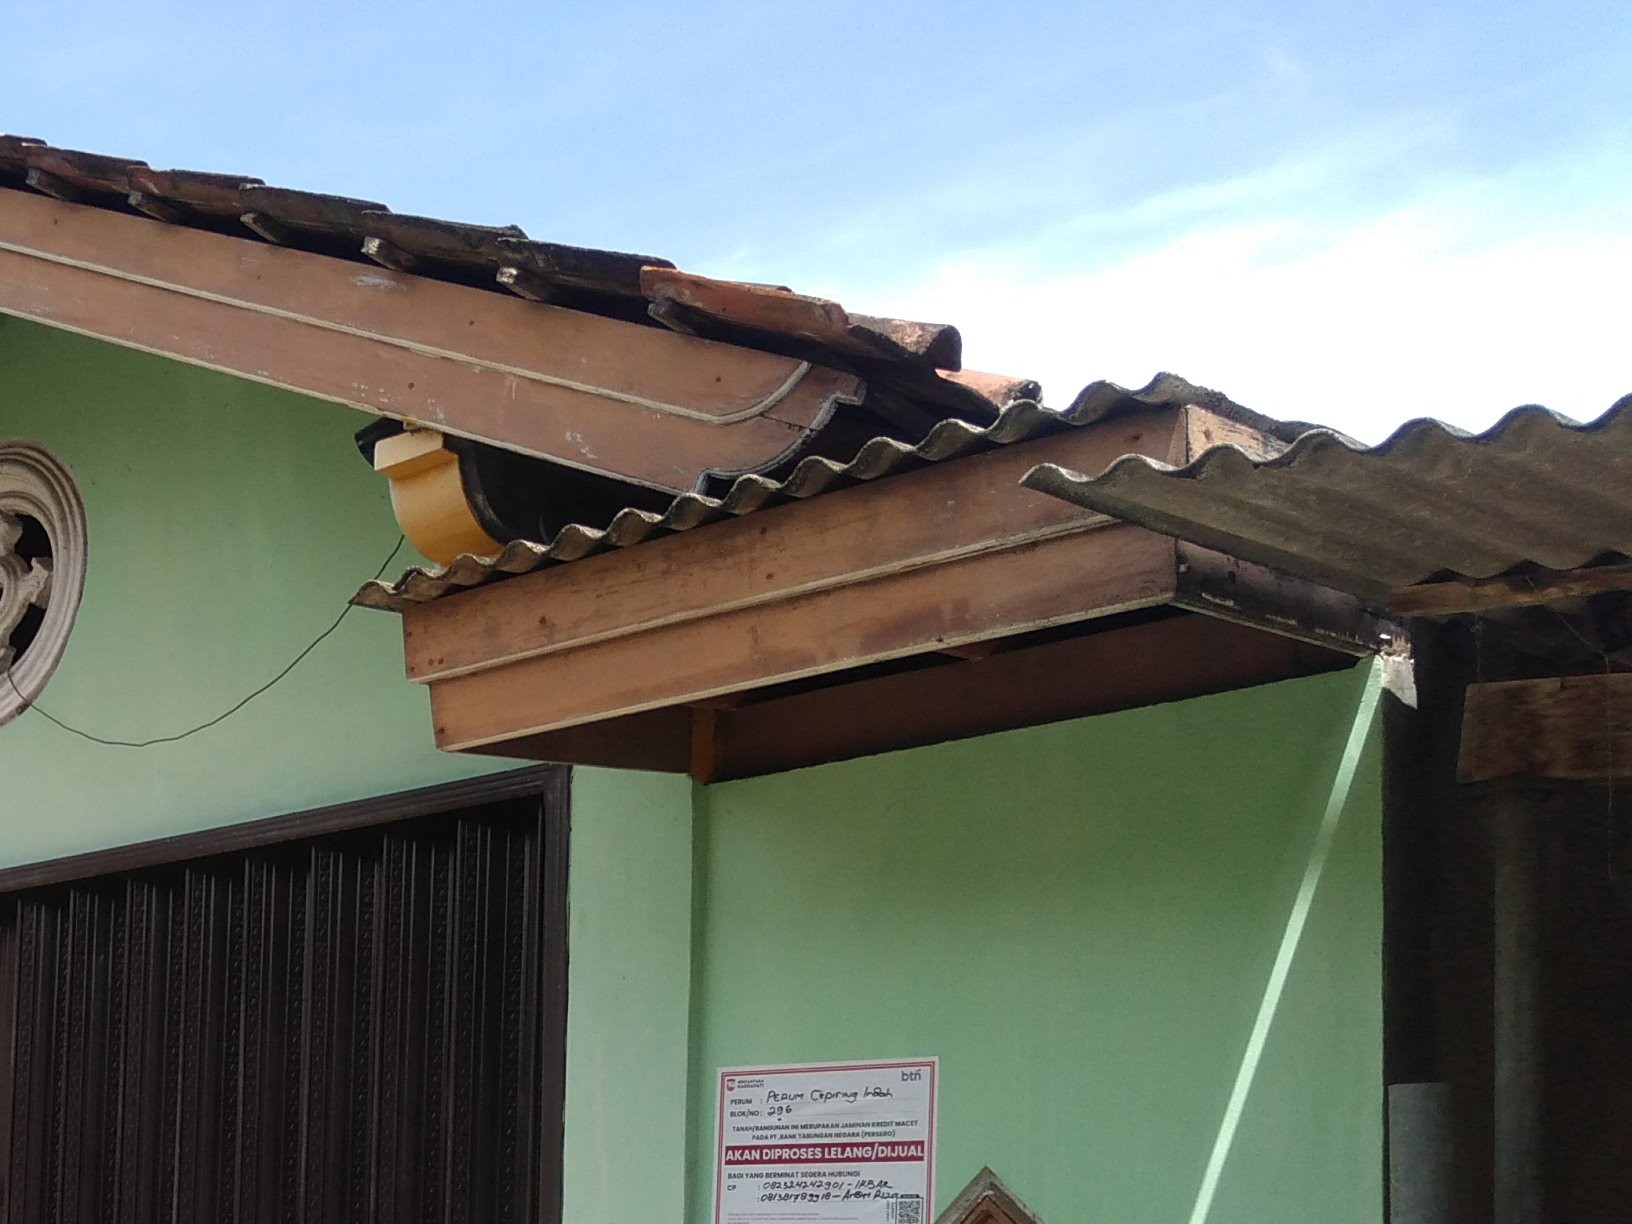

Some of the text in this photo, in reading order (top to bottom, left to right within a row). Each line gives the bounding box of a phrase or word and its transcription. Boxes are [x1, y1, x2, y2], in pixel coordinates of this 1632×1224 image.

[901, 1069, 921, 1081] btn
[732, 1124, 789, 1132] TANAH/BANGUNAN
[861, 1129, 896, 1139] (PERSERO)
[726, 1143, 924, 1160] AKAN DIPROSES LELANG/DIJUAL
[727, 1172, 744, 1180] BAGI
